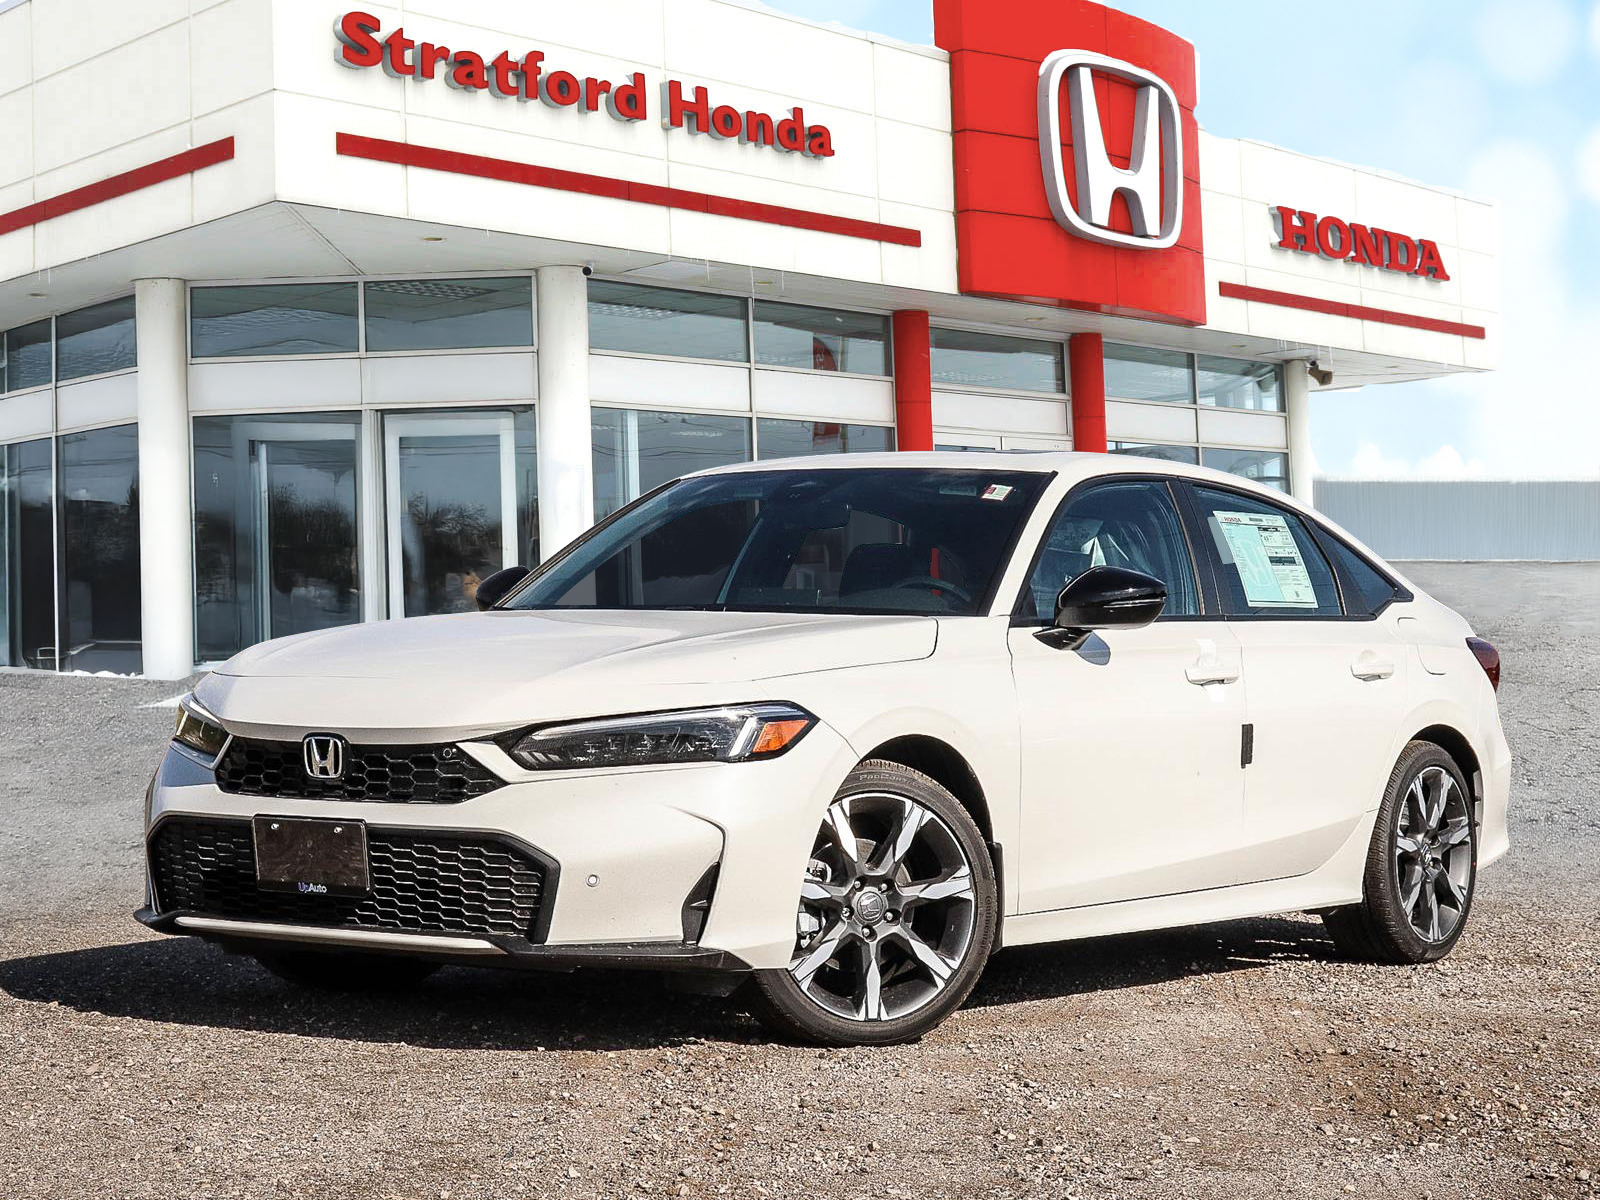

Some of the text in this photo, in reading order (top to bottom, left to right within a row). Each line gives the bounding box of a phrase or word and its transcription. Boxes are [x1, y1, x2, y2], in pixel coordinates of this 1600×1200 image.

[334, 11, 835, 158] Stratford Honda
[1271, 205, 1450, 282] HONDA
